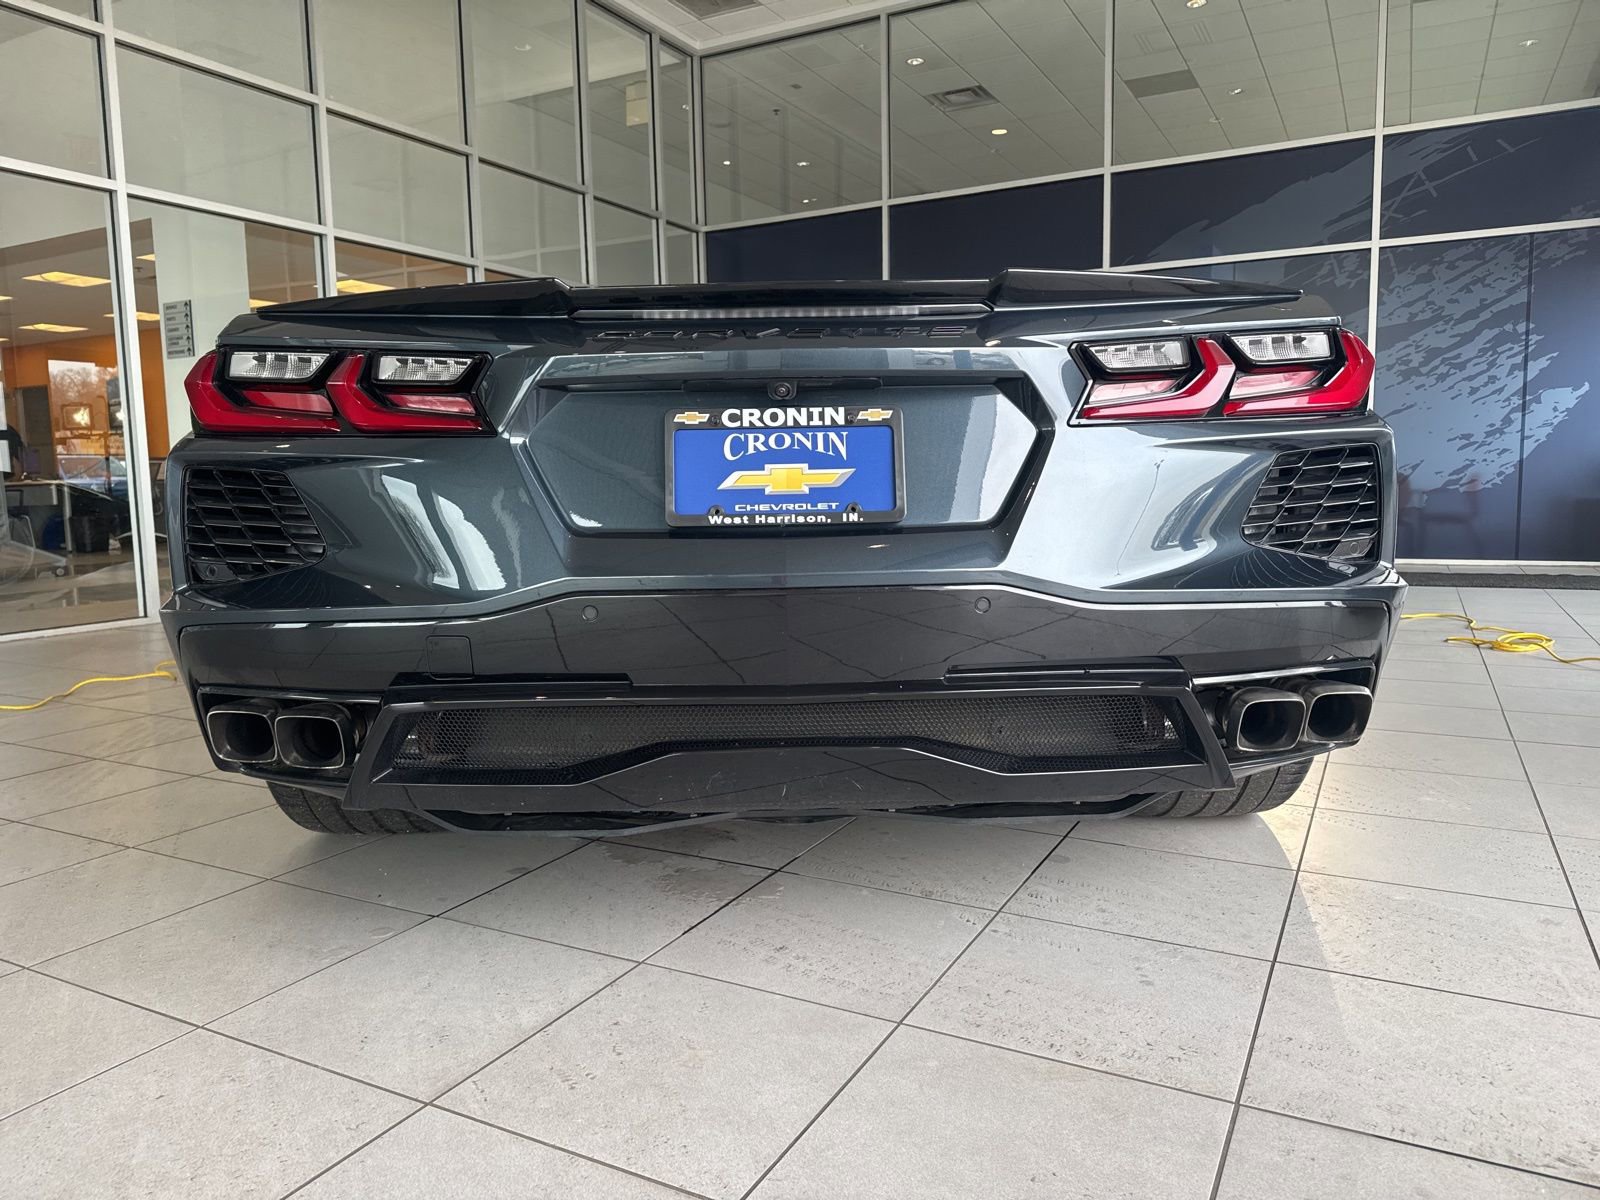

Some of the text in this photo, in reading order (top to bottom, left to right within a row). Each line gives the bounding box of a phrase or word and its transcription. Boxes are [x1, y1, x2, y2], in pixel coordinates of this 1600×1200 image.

[722, 407, 845, 427] CRONIN
[724, 432, 848, 460] CRONIN
[735, 503, 839, 511] CHEVROLET
[708, 513, 863, 524] West Harrison, IN.
